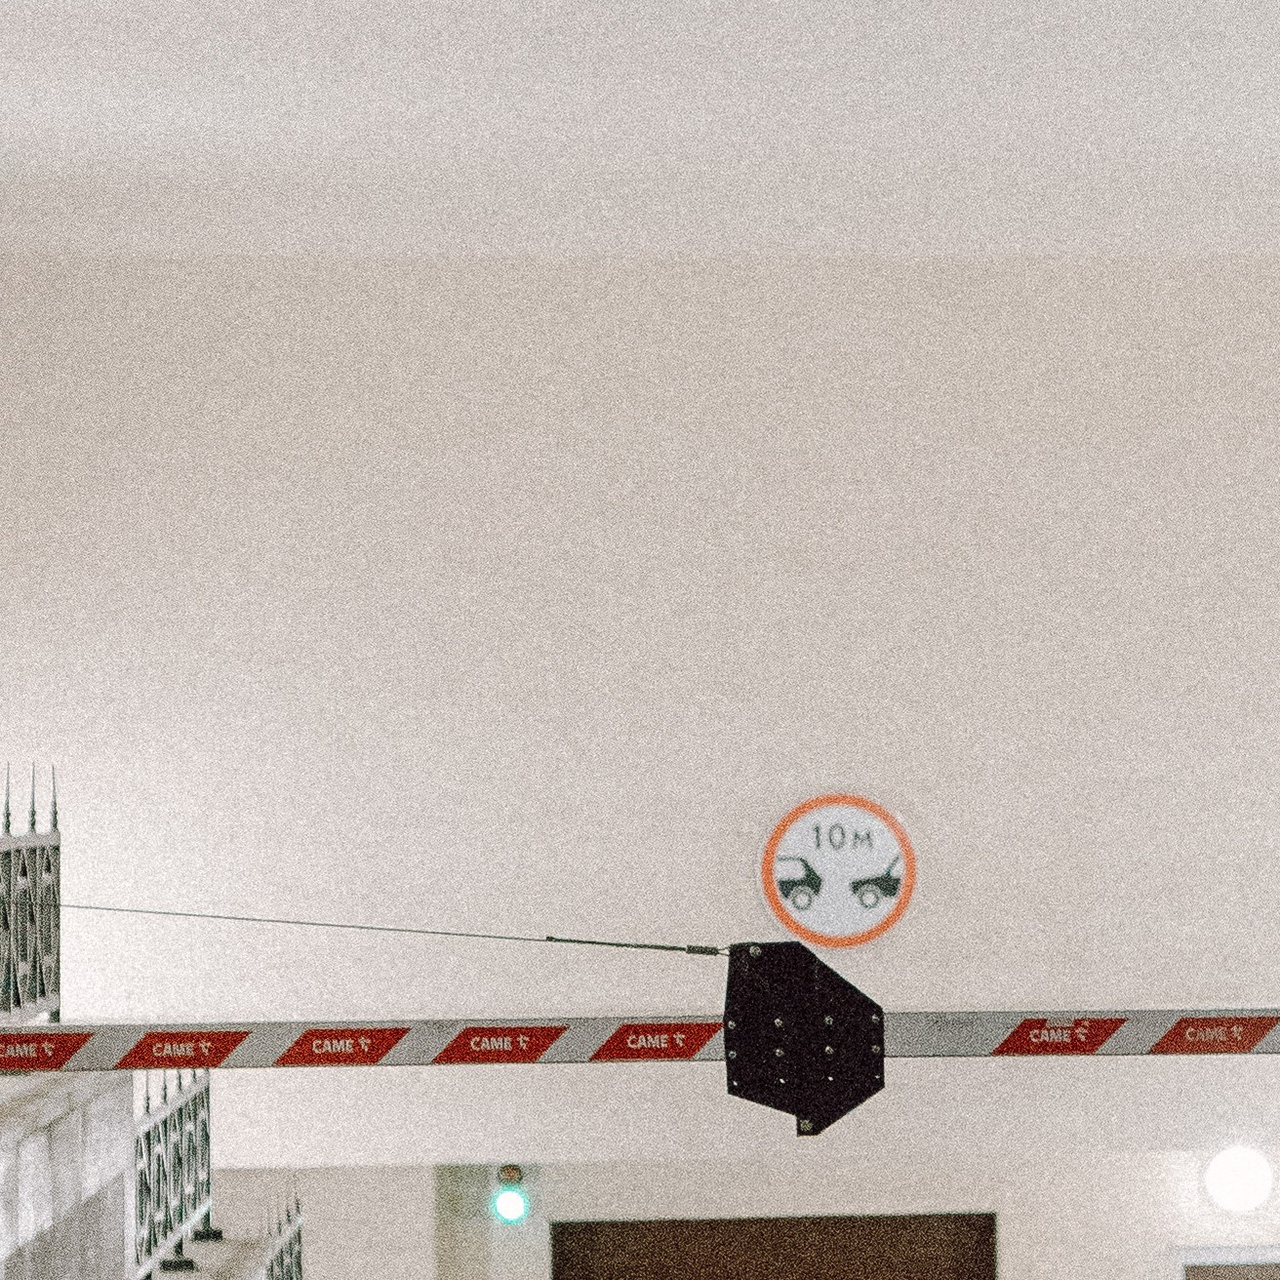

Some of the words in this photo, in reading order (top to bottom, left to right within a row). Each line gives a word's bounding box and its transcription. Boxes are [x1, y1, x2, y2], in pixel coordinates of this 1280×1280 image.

[1029, 1029, 1071, 1043] CAME
[1185, 1027, 1228, 1041] CAME
[312, 1038, 354, 1054] CAME
[470, 1037, 512, 1051] CAME
[627, 1034, 669, 1049] CAME
[152, 1042, 195, 1057] CAME
